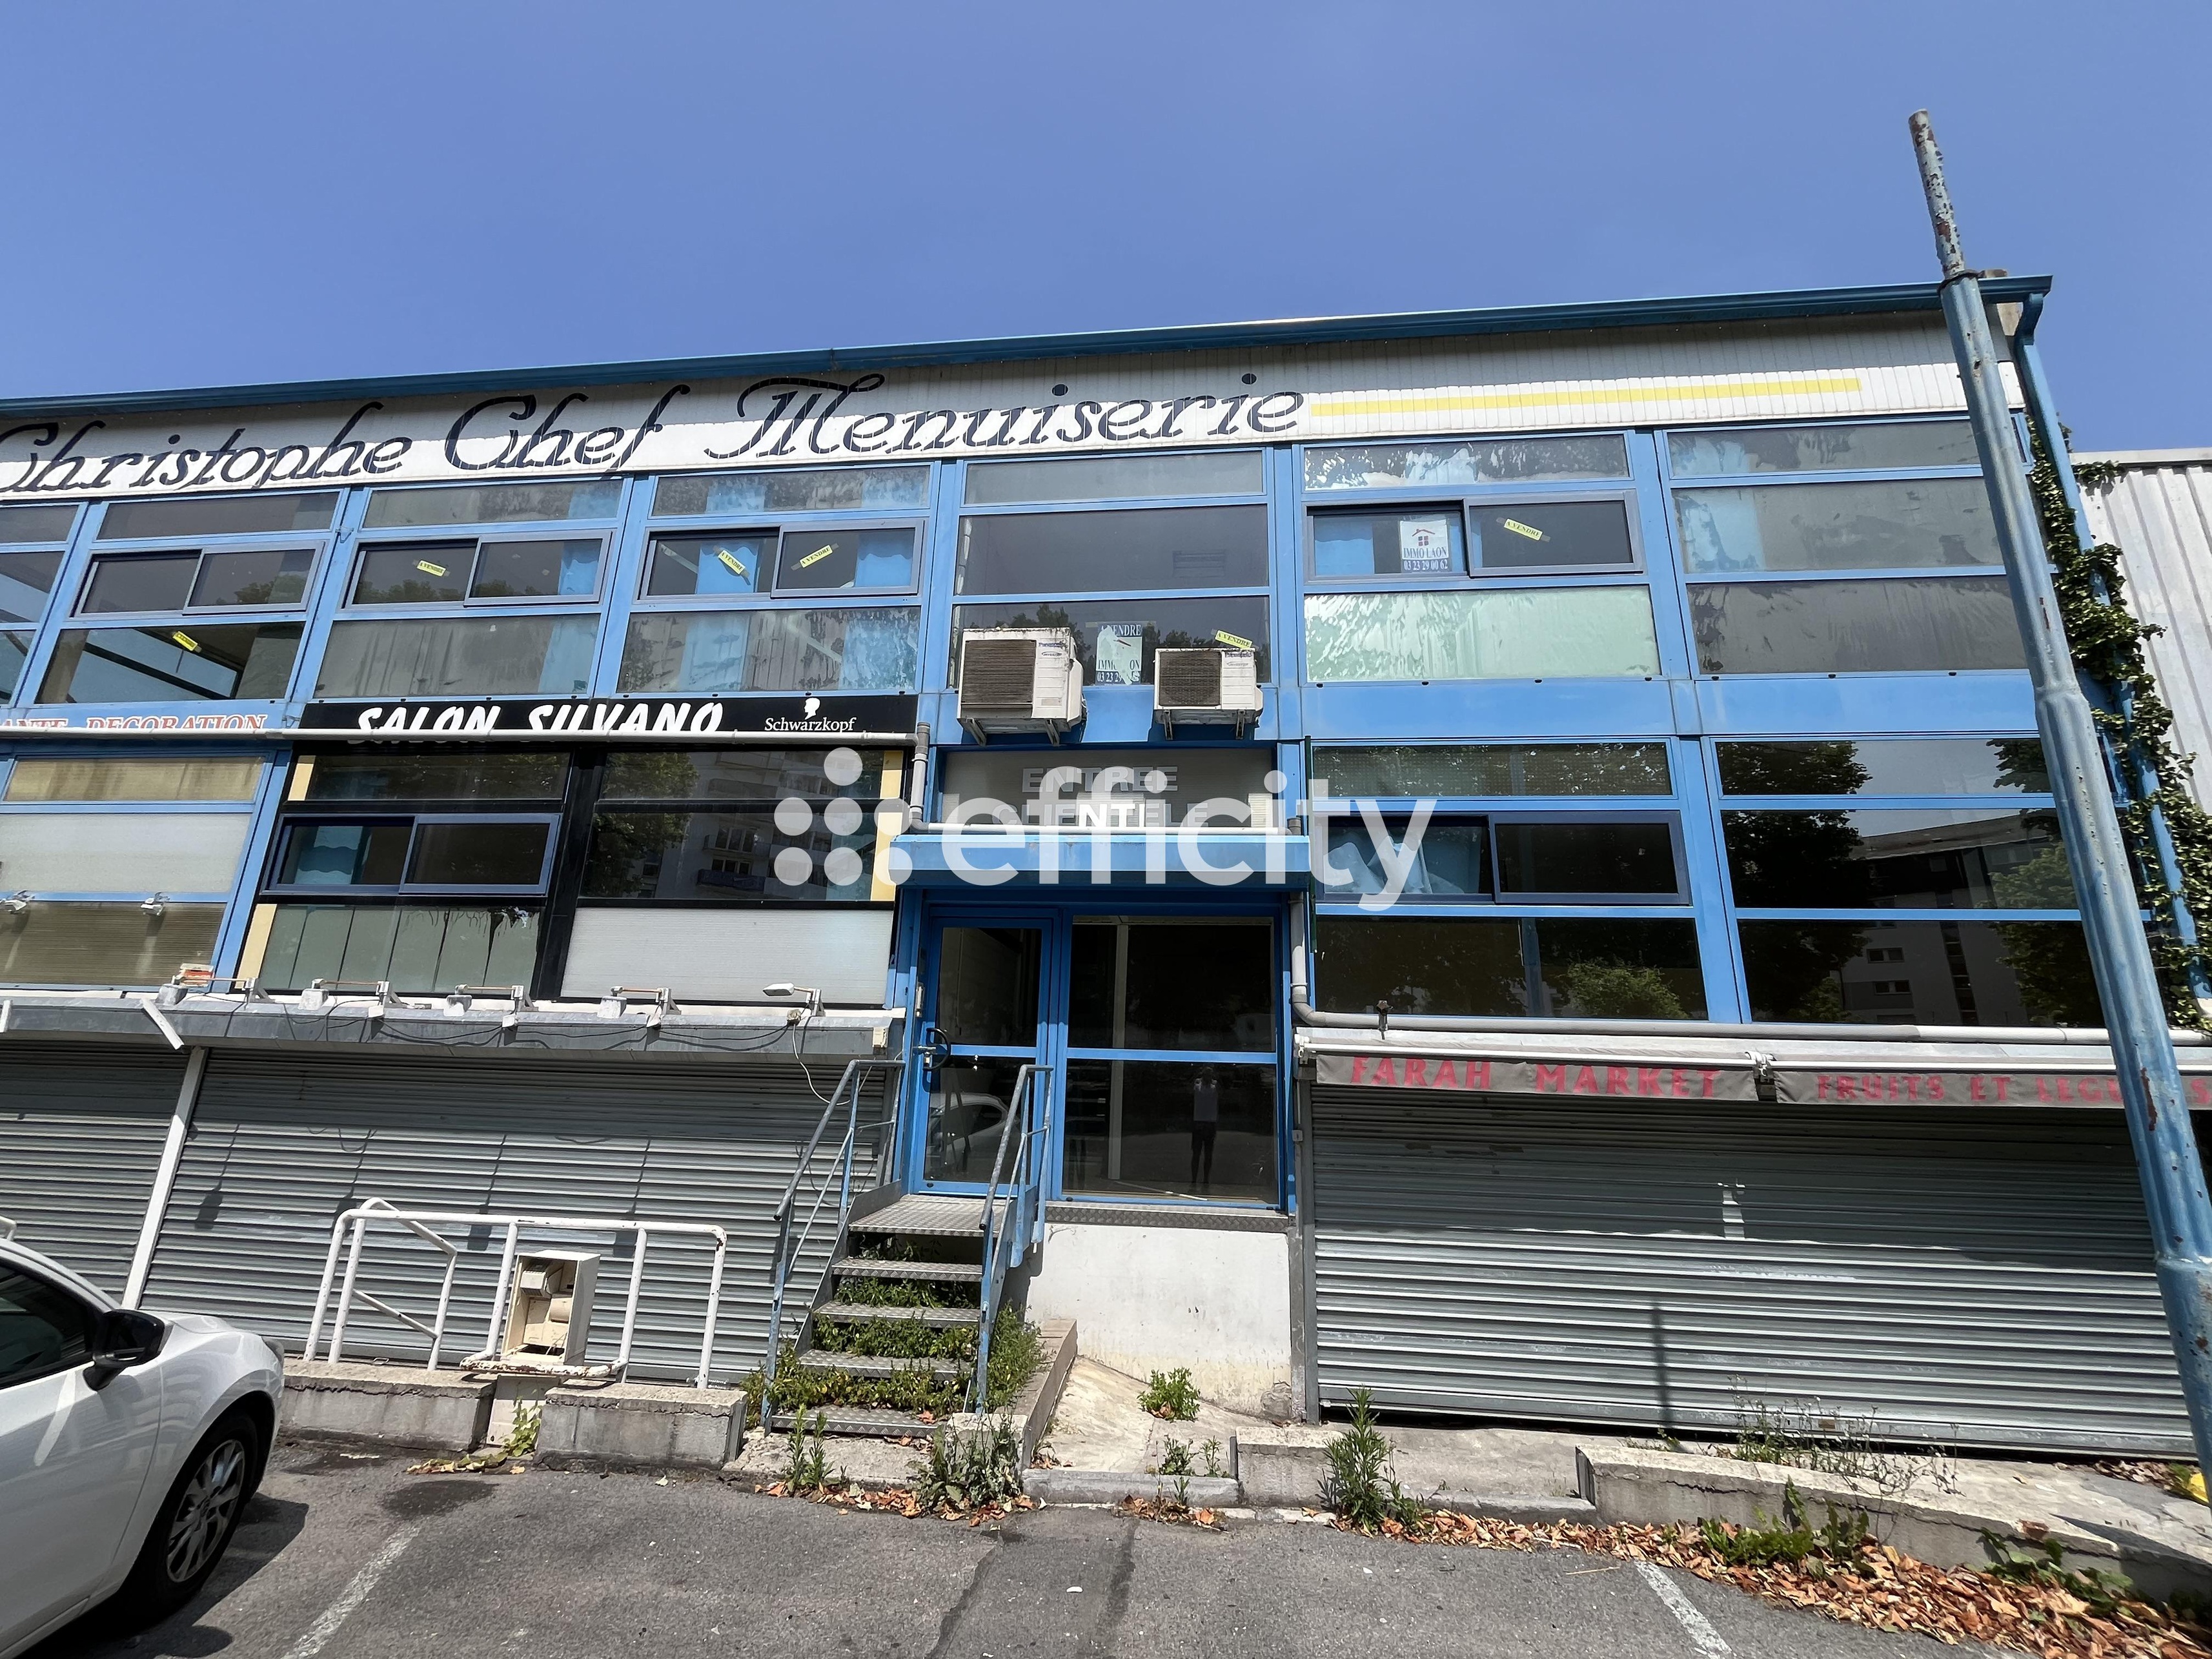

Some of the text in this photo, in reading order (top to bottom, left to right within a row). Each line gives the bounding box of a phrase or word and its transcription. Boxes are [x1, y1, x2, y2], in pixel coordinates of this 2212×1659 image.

[0, 372, 1304, 490] Christophe Chef Menuiserie
[1403, 546, 1448, 558] IMMO LAON
[1403, 558, 1448, 571] 03 23 29 00 62
[764, 717, 857, 733] Schwarzkopf
[1350, 1055, 1723, 1098] FARAH MARKET
[1816, 1074, 1945, 1102] FRUITS
[1970, 1075, 2012, 1102] ET
